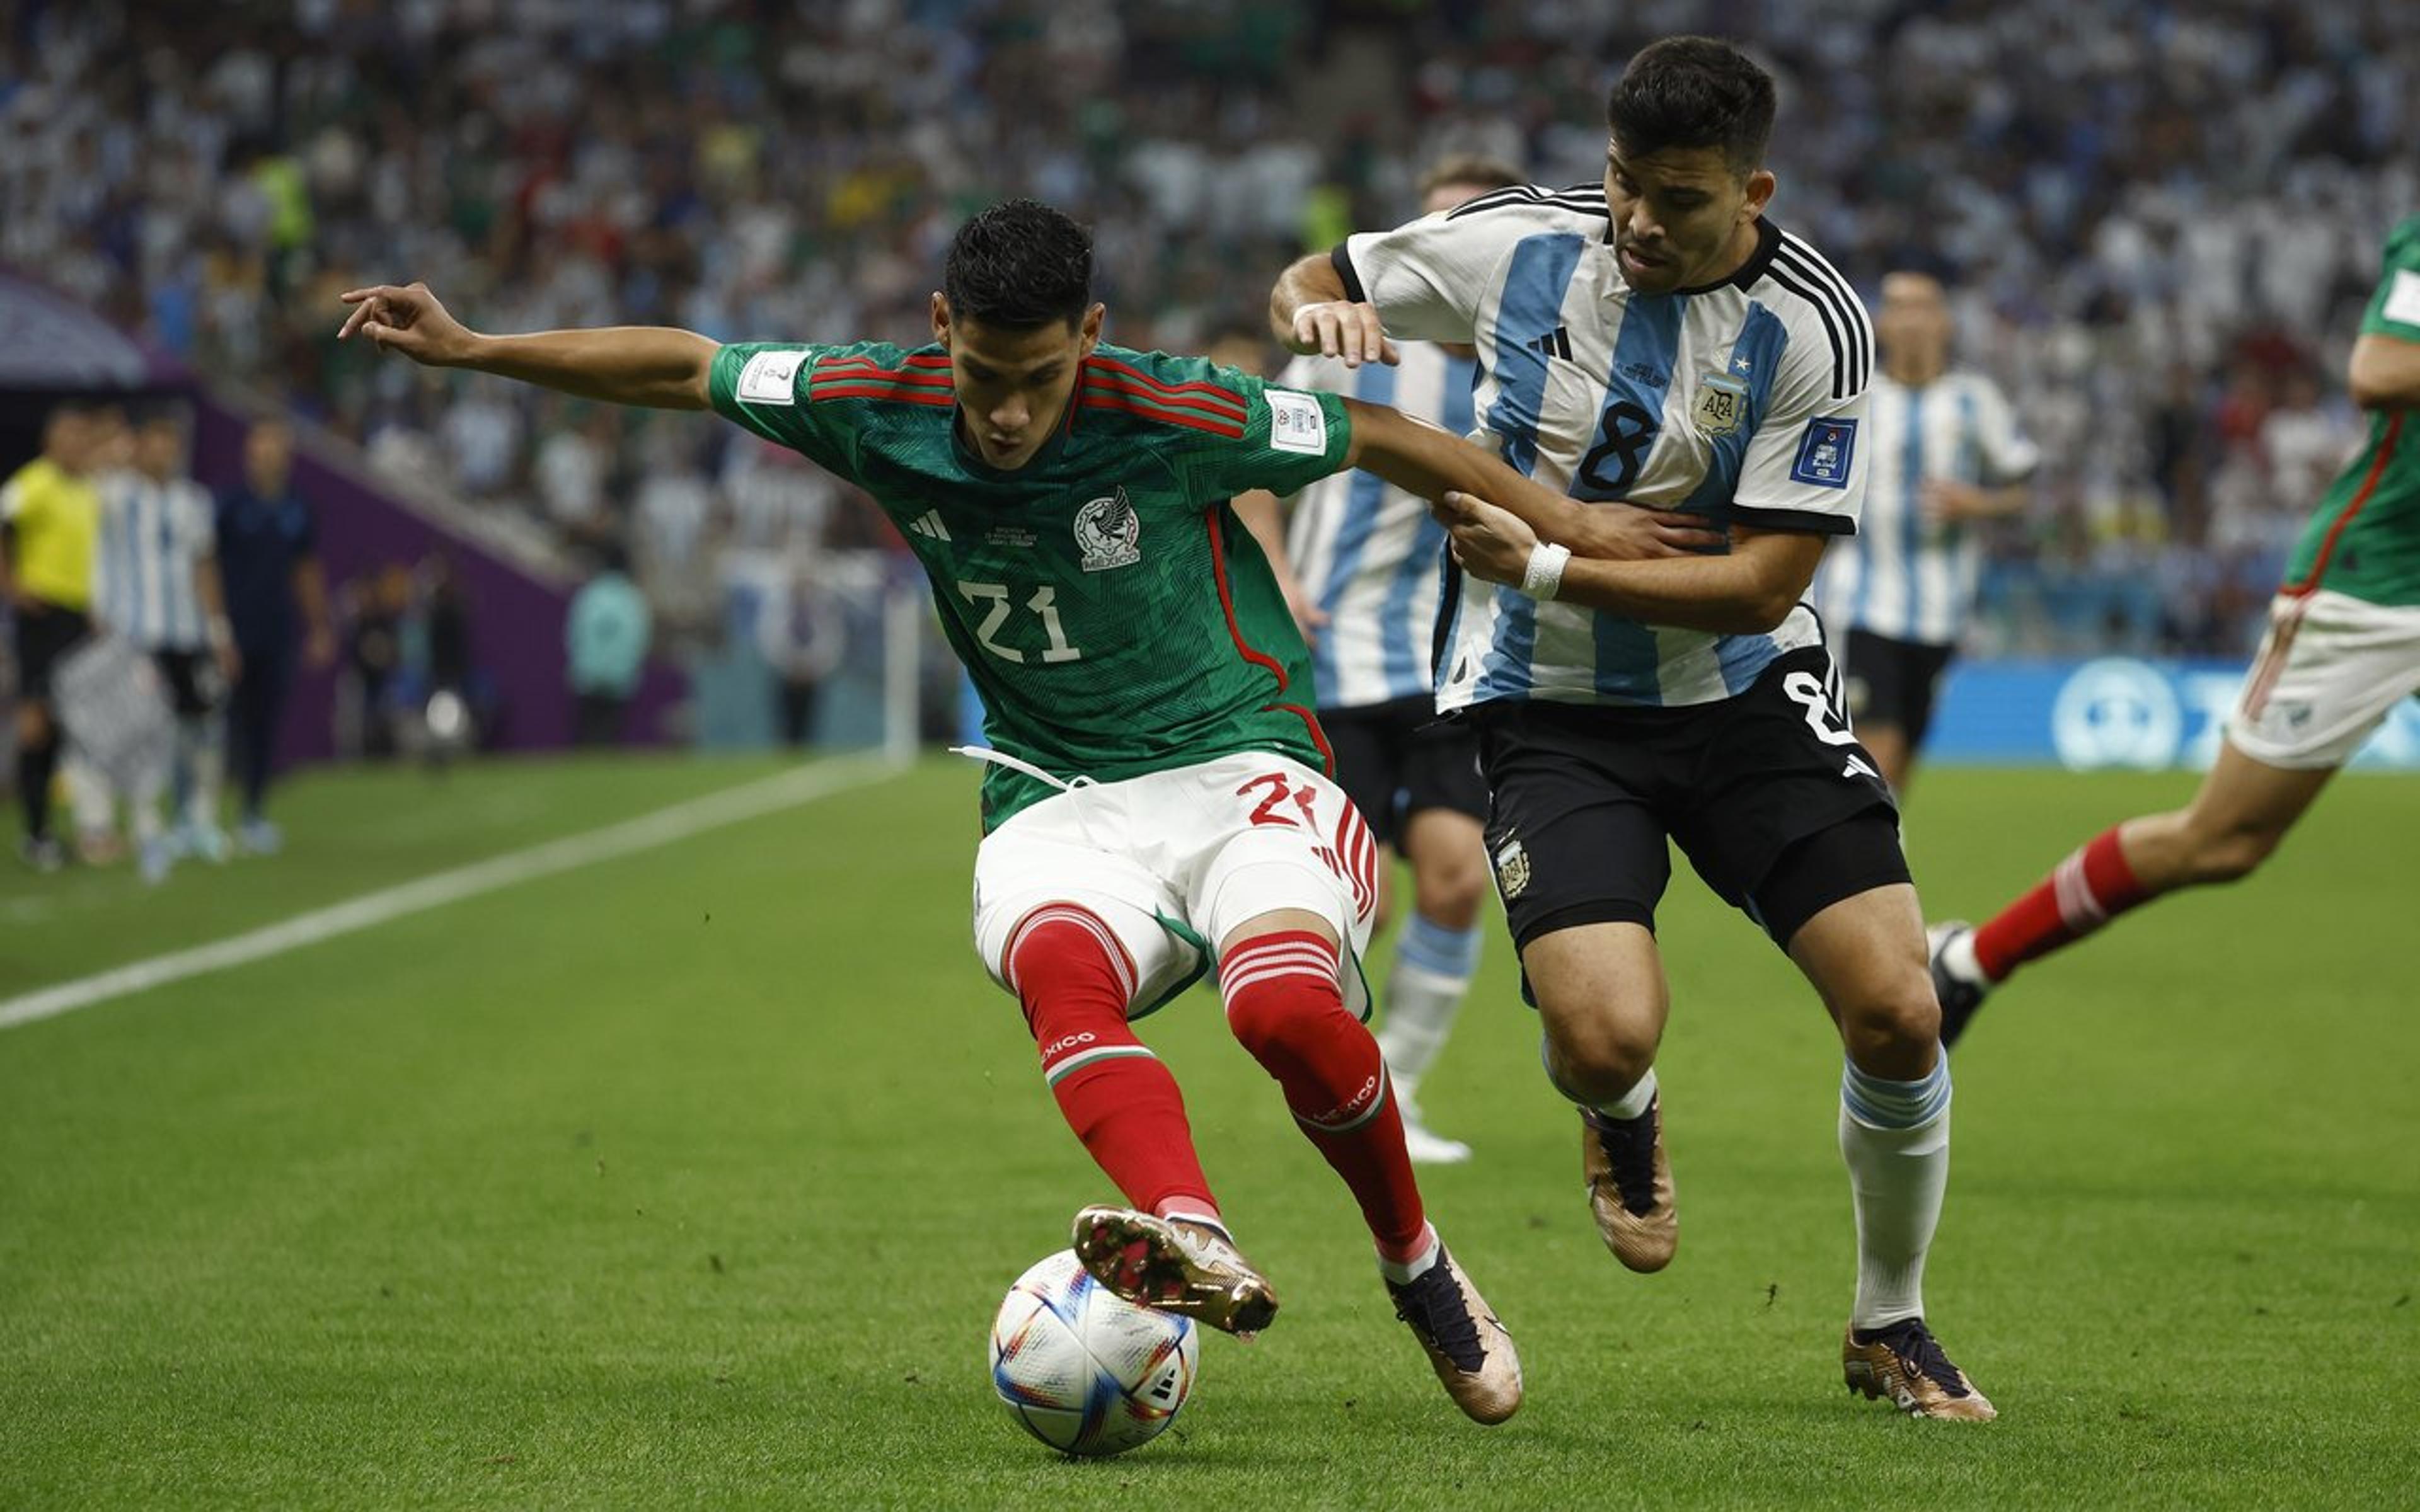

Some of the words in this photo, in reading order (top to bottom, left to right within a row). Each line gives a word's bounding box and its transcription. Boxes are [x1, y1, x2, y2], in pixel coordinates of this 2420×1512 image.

[1702, 388, 1733, 421] AFA
[1578, 400, 1660, 490] 8
[957, 580, 1081, 663] 21
[1782, 671, 1860, 745] 8
[1236, 772, 1322, 839] 21
